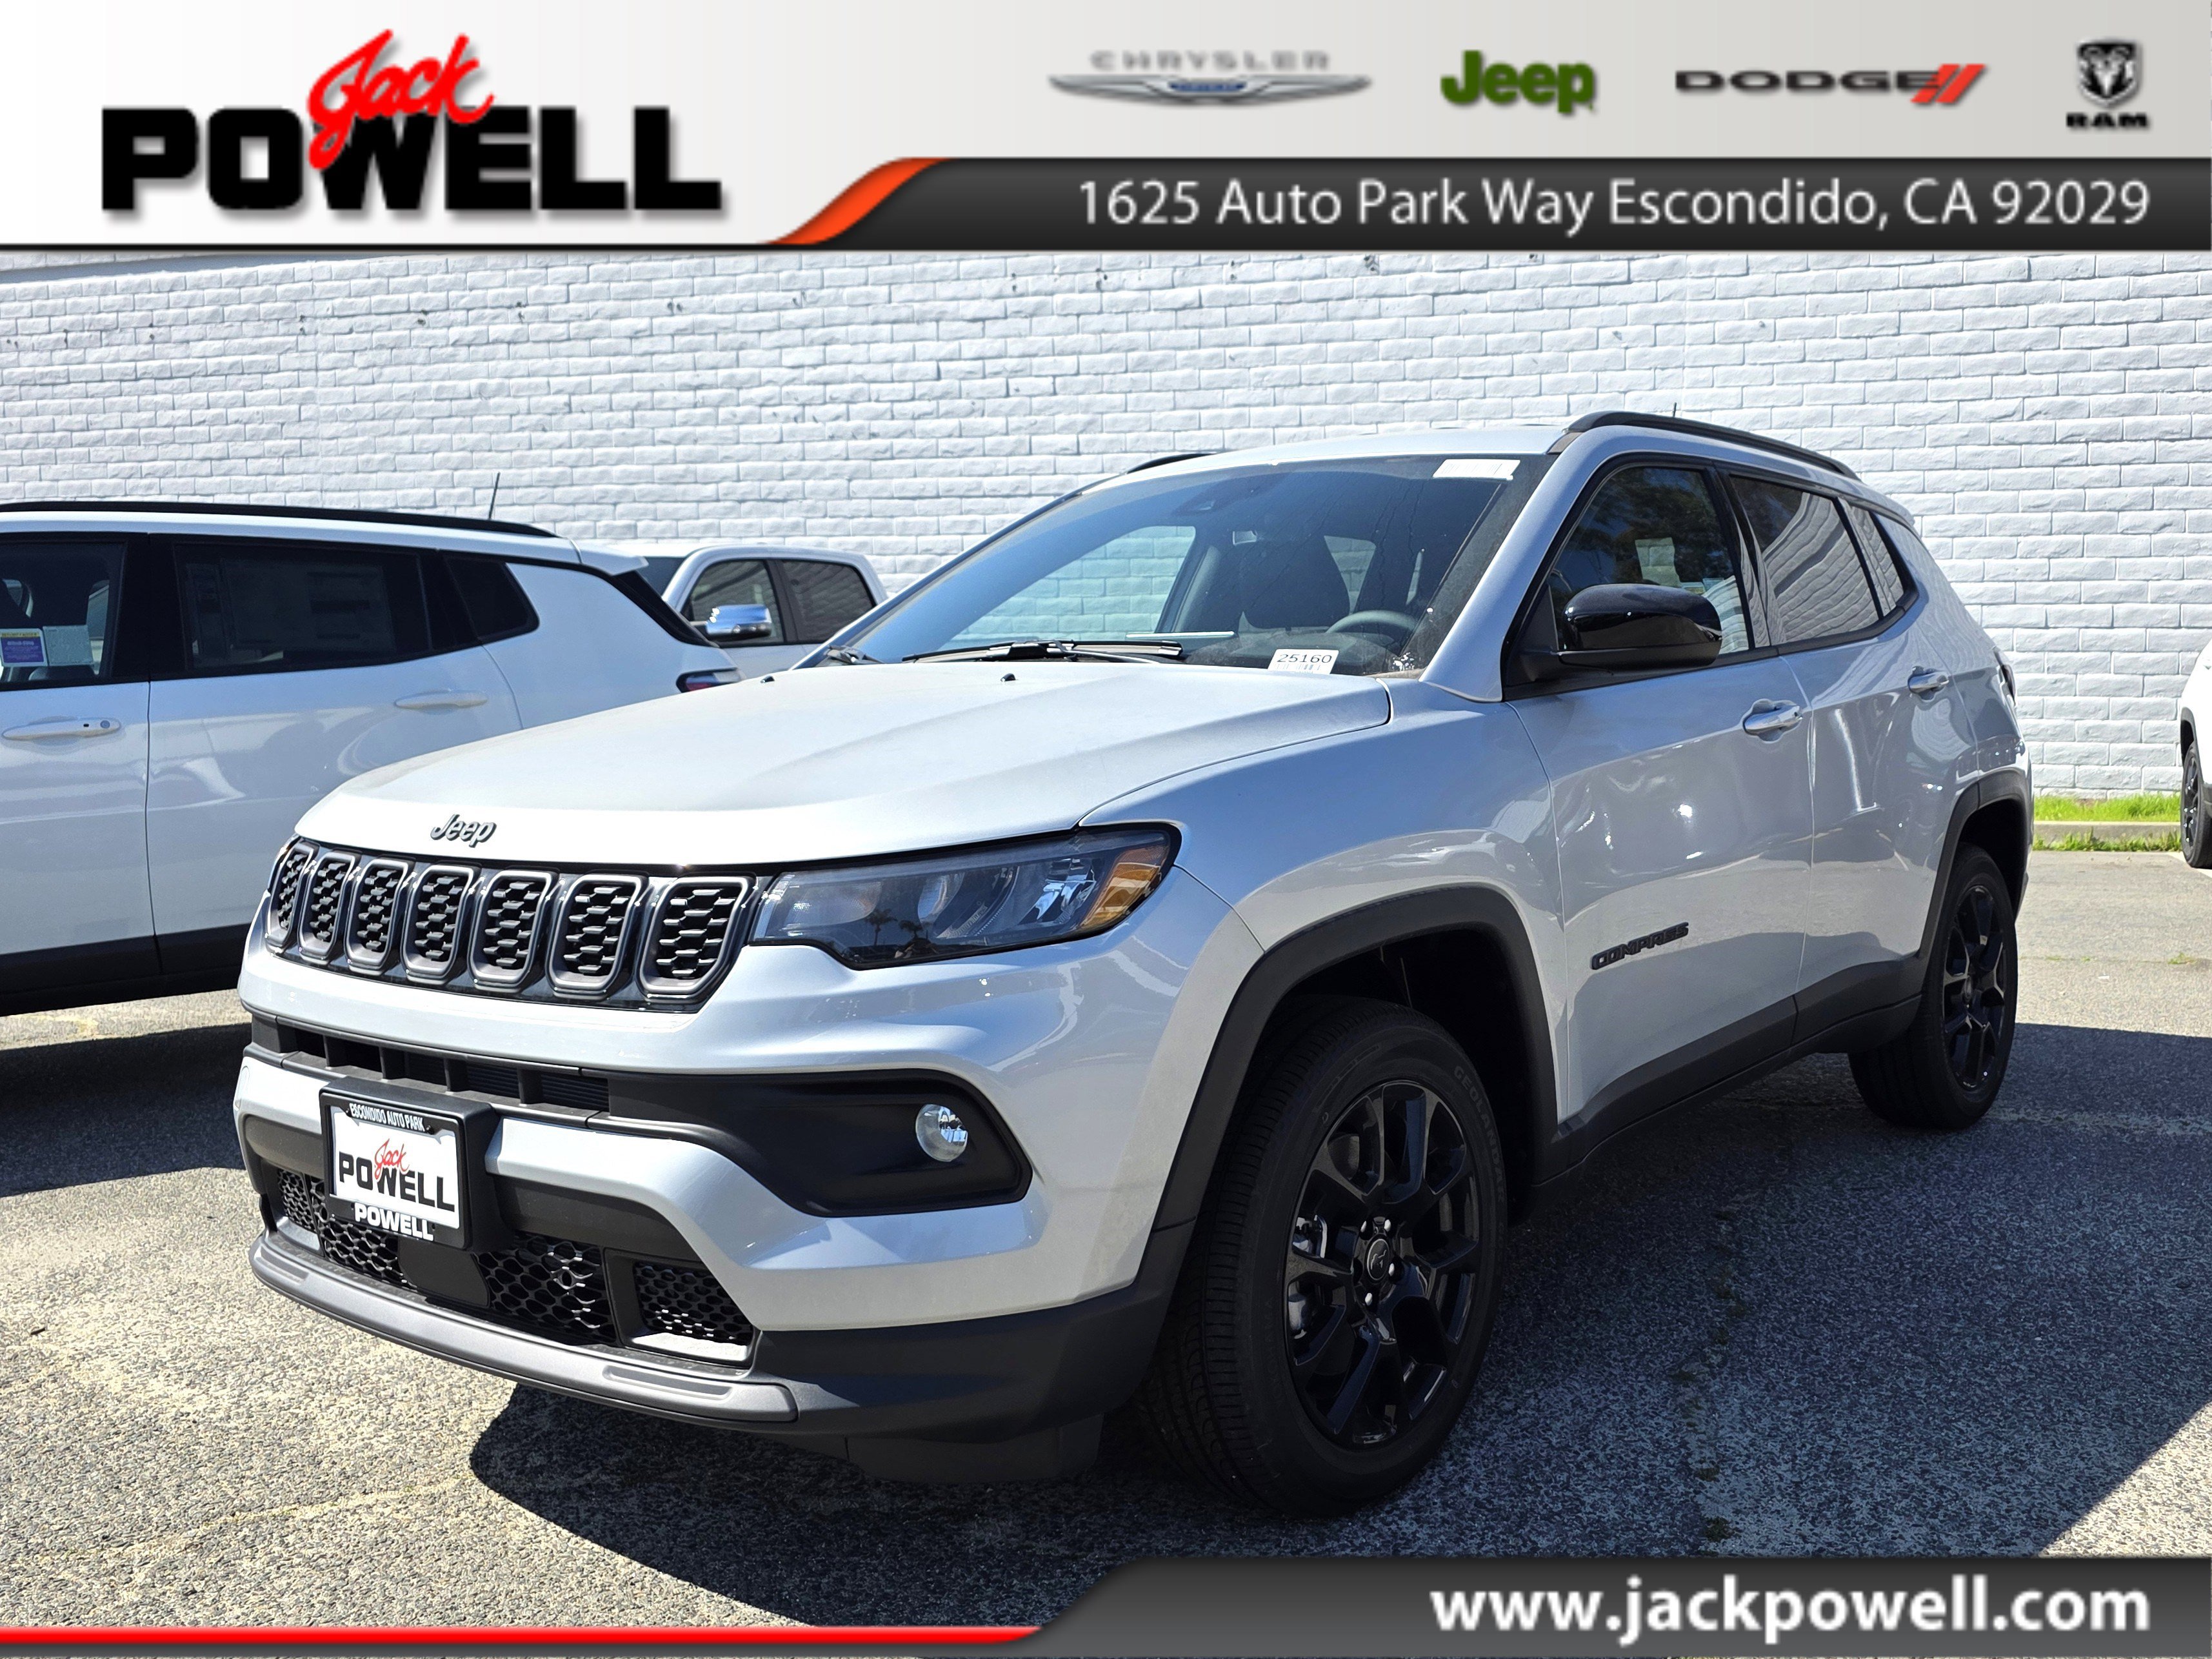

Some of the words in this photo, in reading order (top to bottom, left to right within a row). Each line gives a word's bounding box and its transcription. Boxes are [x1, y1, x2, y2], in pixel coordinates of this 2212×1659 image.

[1277, 653, 1332, 663] 25160
[430, 813, 497, 848] Jeep
[349, 1103, 387, 1124] ESCONDIDO
[386, 1111, 406, 1128] AUTO
[404, 1114, 425, 1132] PARK
[1453, 1065, 1504, 1203] GEOLANDAR
[374, 1138, 410, 1180] Jack
[339, 1151, 455, 1212] POWELL
[354, 1202, 434, 1241] POWELL
